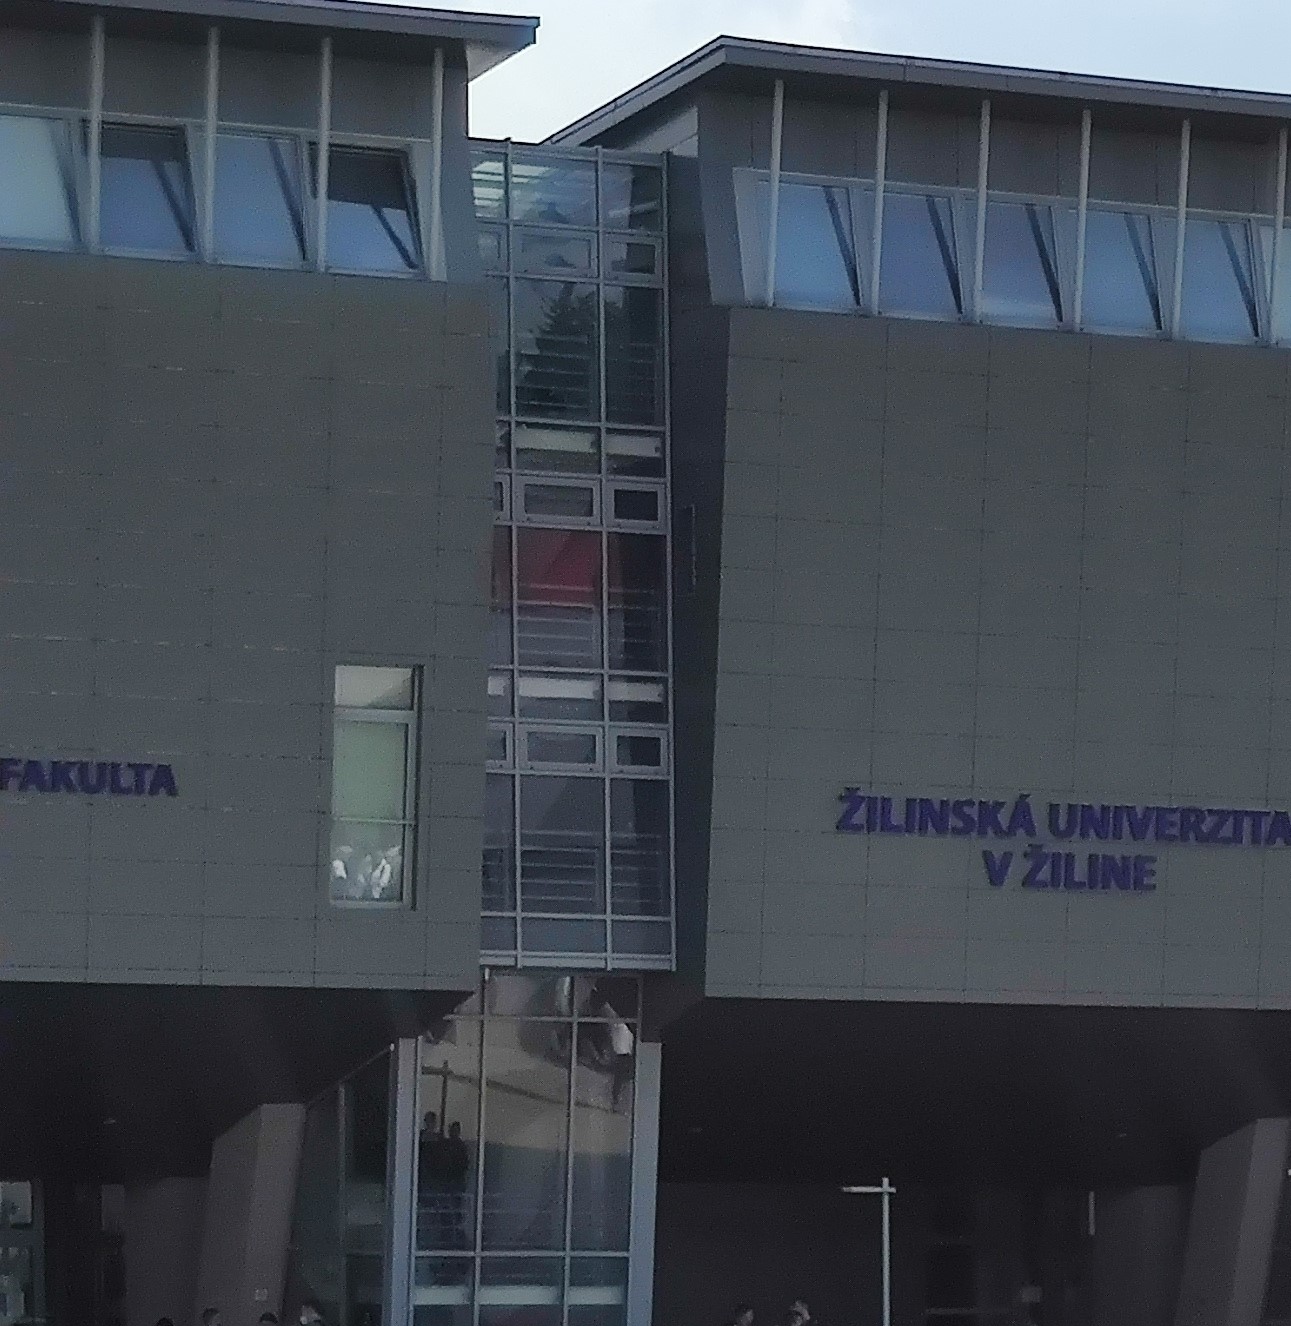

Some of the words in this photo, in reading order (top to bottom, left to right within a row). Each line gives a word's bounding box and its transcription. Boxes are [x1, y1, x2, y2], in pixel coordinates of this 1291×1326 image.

[0, 757, 178, 796] FAKULTA
[835, 787, 1037, 838] ŽILINSKÁ
[982, 849, 1014, 887] V
[1021, 843, 1158, 891] ŽILINE
